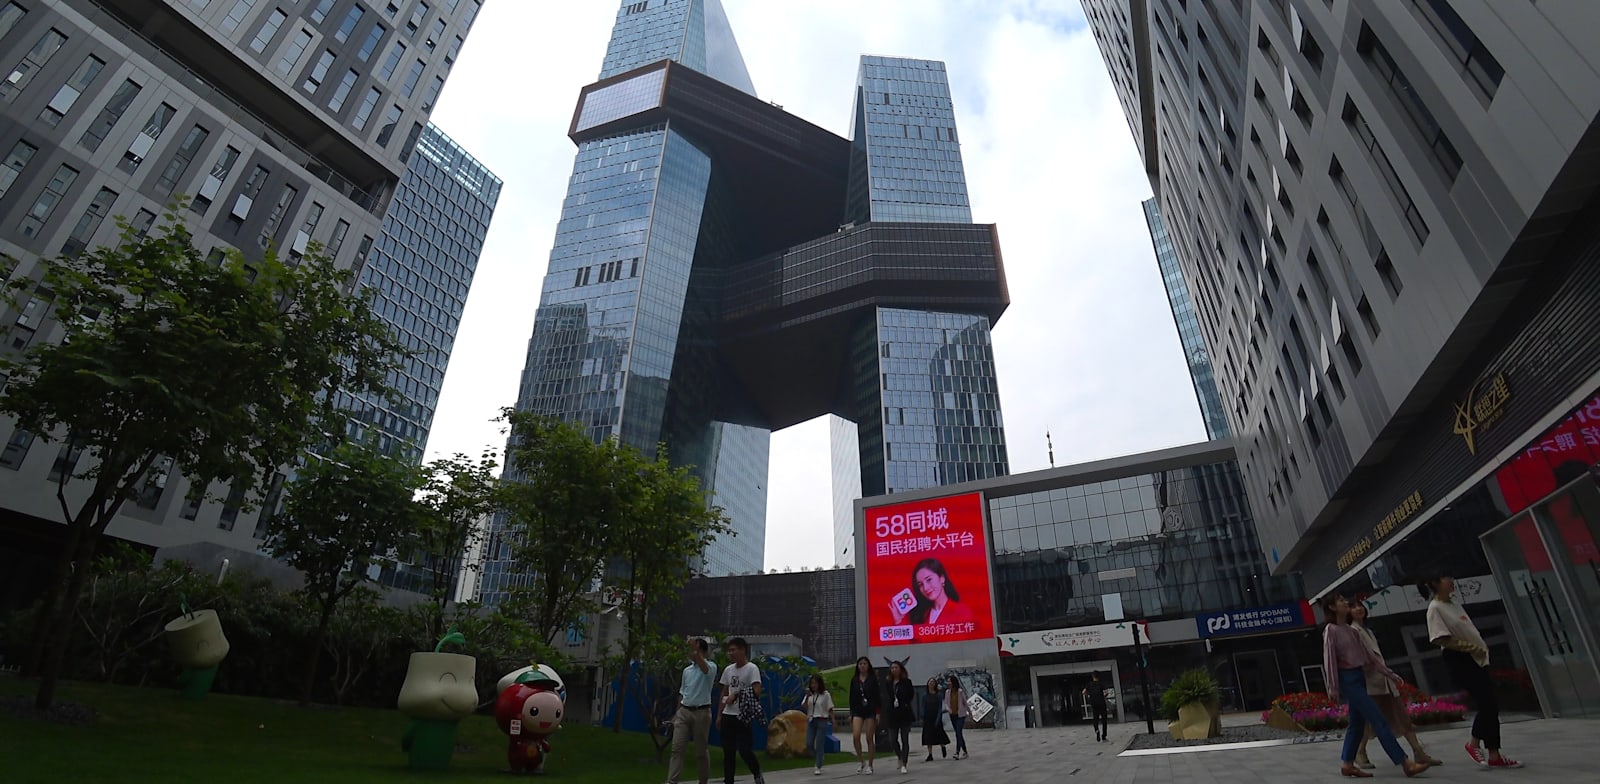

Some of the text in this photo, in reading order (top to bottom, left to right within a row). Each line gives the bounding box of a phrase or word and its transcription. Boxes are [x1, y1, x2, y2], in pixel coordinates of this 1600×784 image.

[875, 508, 949, 538] 58同城
[876, 531, 974, 556] 国民招聘大平台
[897, 593, 913, 609] 58
[1232, 611, 1259, 621] 浦发银行
[1272, 608, 1290, 616] BANK
[918, 622, 974, 635] 360行好工作
